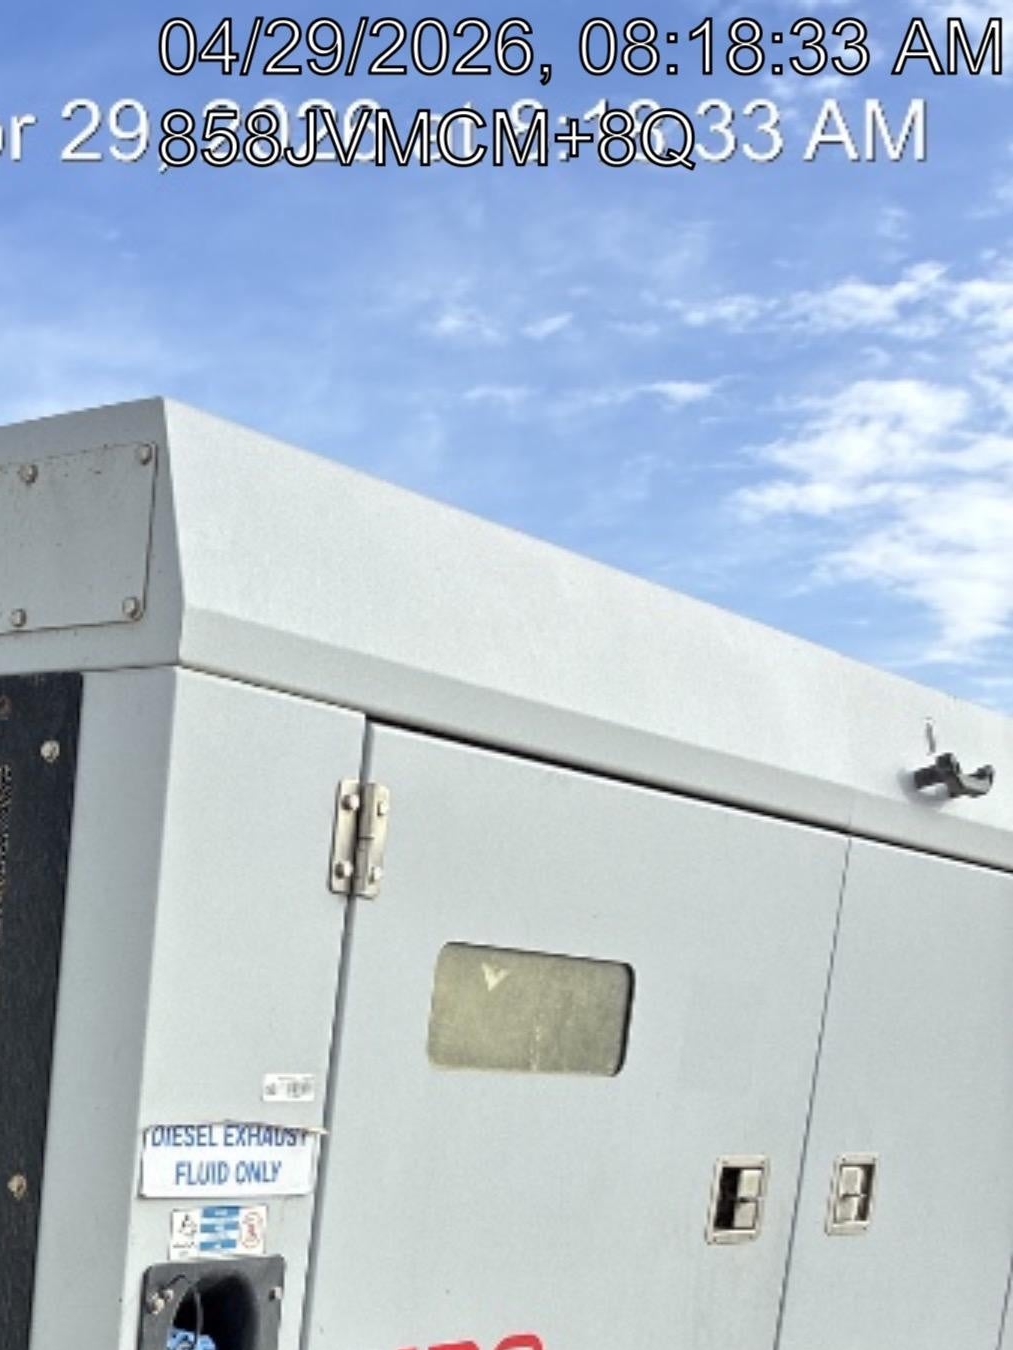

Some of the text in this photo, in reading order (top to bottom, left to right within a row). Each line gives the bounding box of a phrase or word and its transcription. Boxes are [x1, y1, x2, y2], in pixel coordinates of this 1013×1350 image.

[150, 1123, 308, 1148] DIESEL EXHAUST
[174, 1159, 283, 1186] FLUID ONLY
